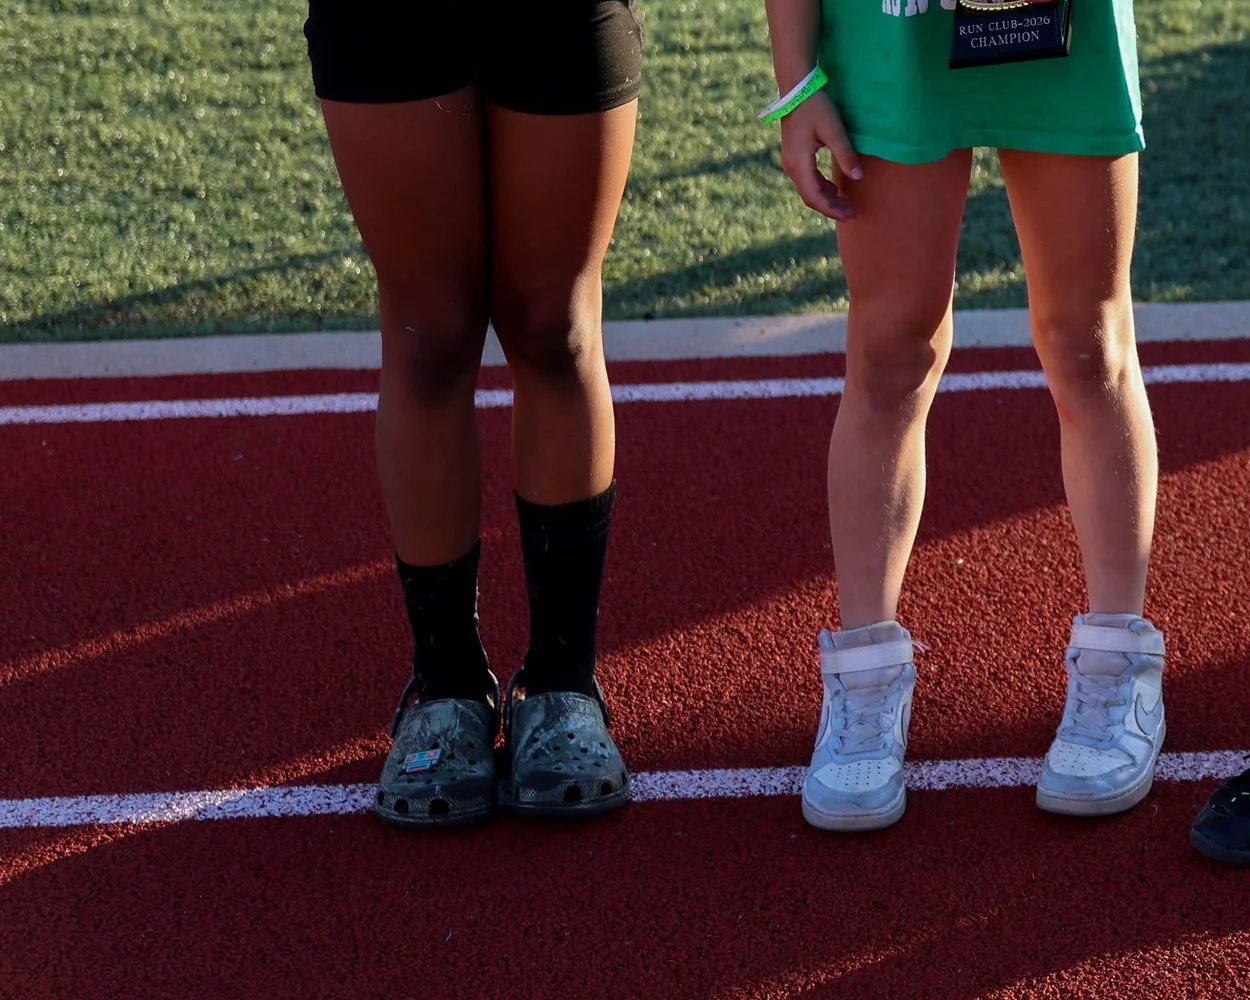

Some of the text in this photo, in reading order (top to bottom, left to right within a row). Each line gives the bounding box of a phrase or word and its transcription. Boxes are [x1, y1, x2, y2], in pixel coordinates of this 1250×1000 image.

[959, 15, 1051, 35] RUN CLUB-2026
[970, 30, 1040, 49] CHAMPION
